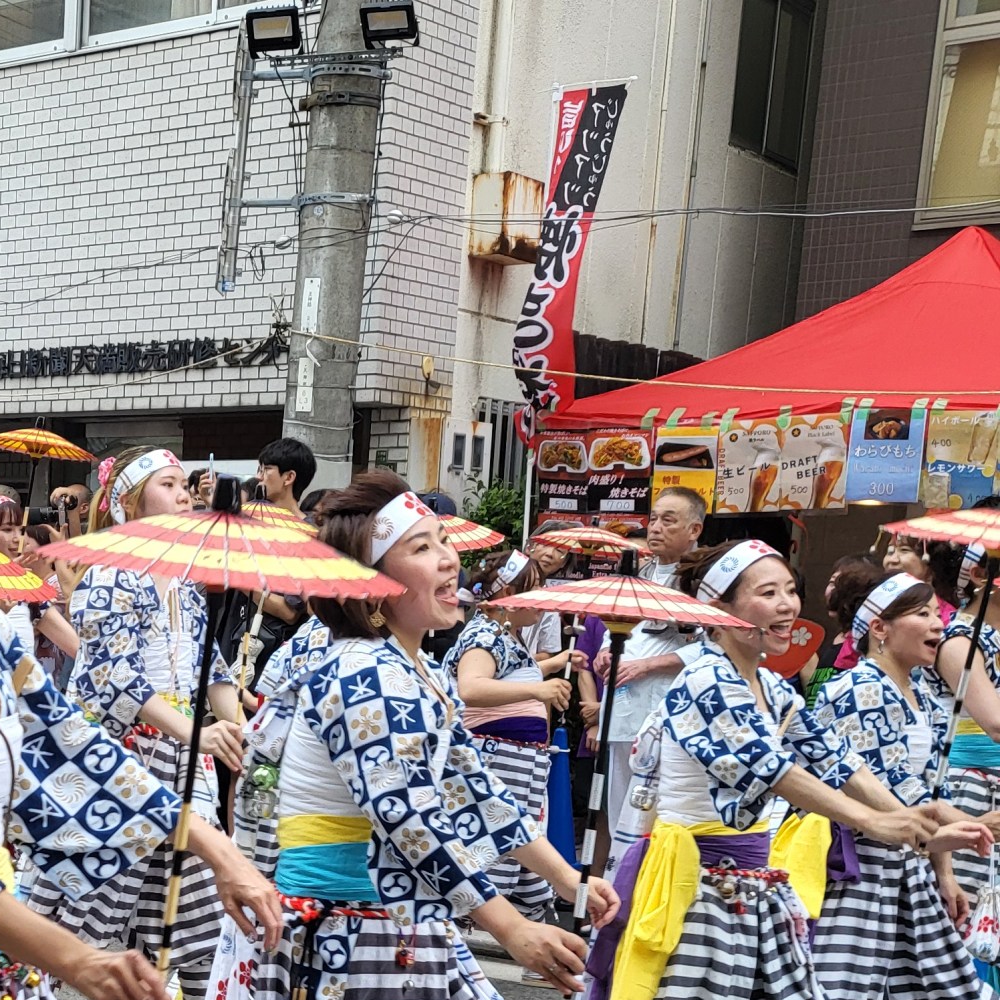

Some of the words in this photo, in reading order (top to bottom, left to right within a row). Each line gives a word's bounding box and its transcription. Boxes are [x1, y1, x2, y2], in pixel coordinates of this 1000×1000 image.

[931, 438, 952, 448] 400
[854, 444, 917, 458] わらびもち
[781, 455, 818, 470] DRAFT
[927, 463, 985, 473] レモンサワー
[723, 462, 771, 479] 生ビール
[796, 466, 827, 479] BEER
[540, 483, 589, 495] 特製焼きそば
[608, 487, 649, 498] 焼きそば
[727, 487, 744, 495] 500
[790, 485, 808, 494] 500
[868, 482, 894, 495] 300
[555, 501, 573, 509] 500
[606, 501, 631, 510] 700
